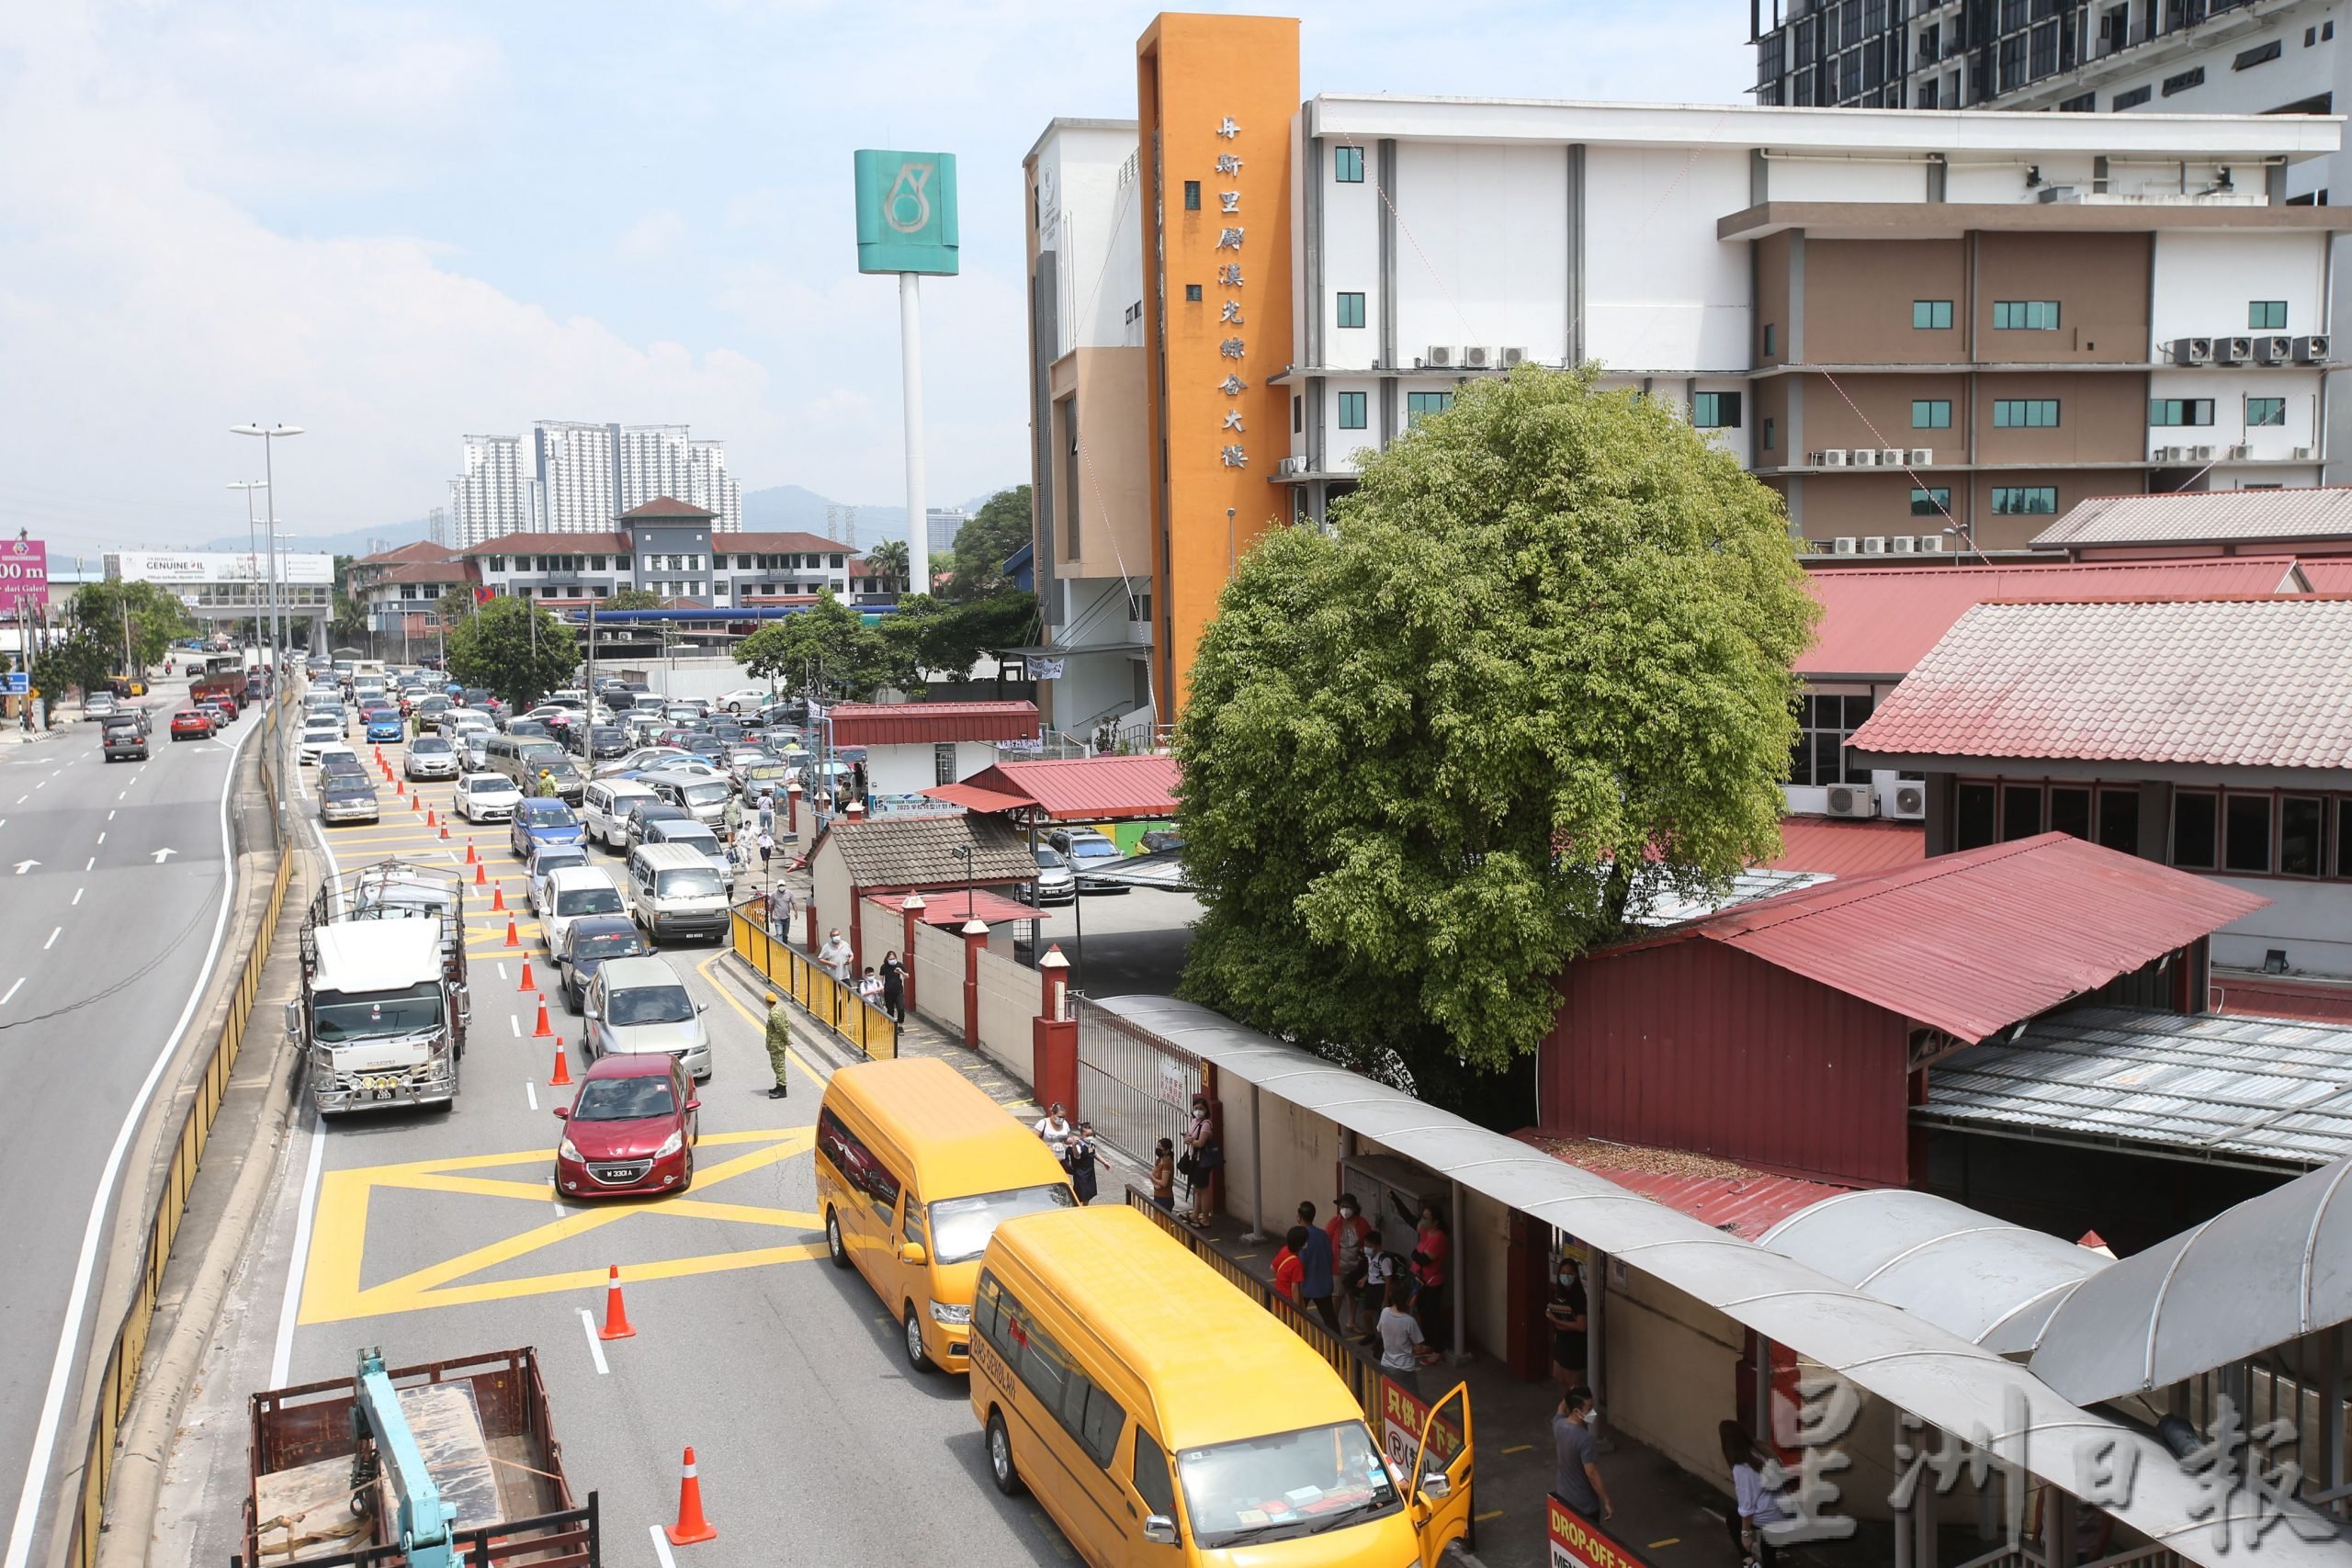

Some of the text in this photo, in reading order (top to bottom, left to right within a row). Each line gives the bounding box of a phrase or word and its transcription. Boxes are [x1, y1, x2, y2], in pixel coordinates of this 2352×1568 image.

[146, 561, 188, 570] GENUINE
[26, 567, 45, 579] m
[5, 584, 46, 592] dari Galeri
[973, 1333, 1016, 1401] BAS SEKOLAH
[1551, 1508, 1615, 1568] DROP-OFF
